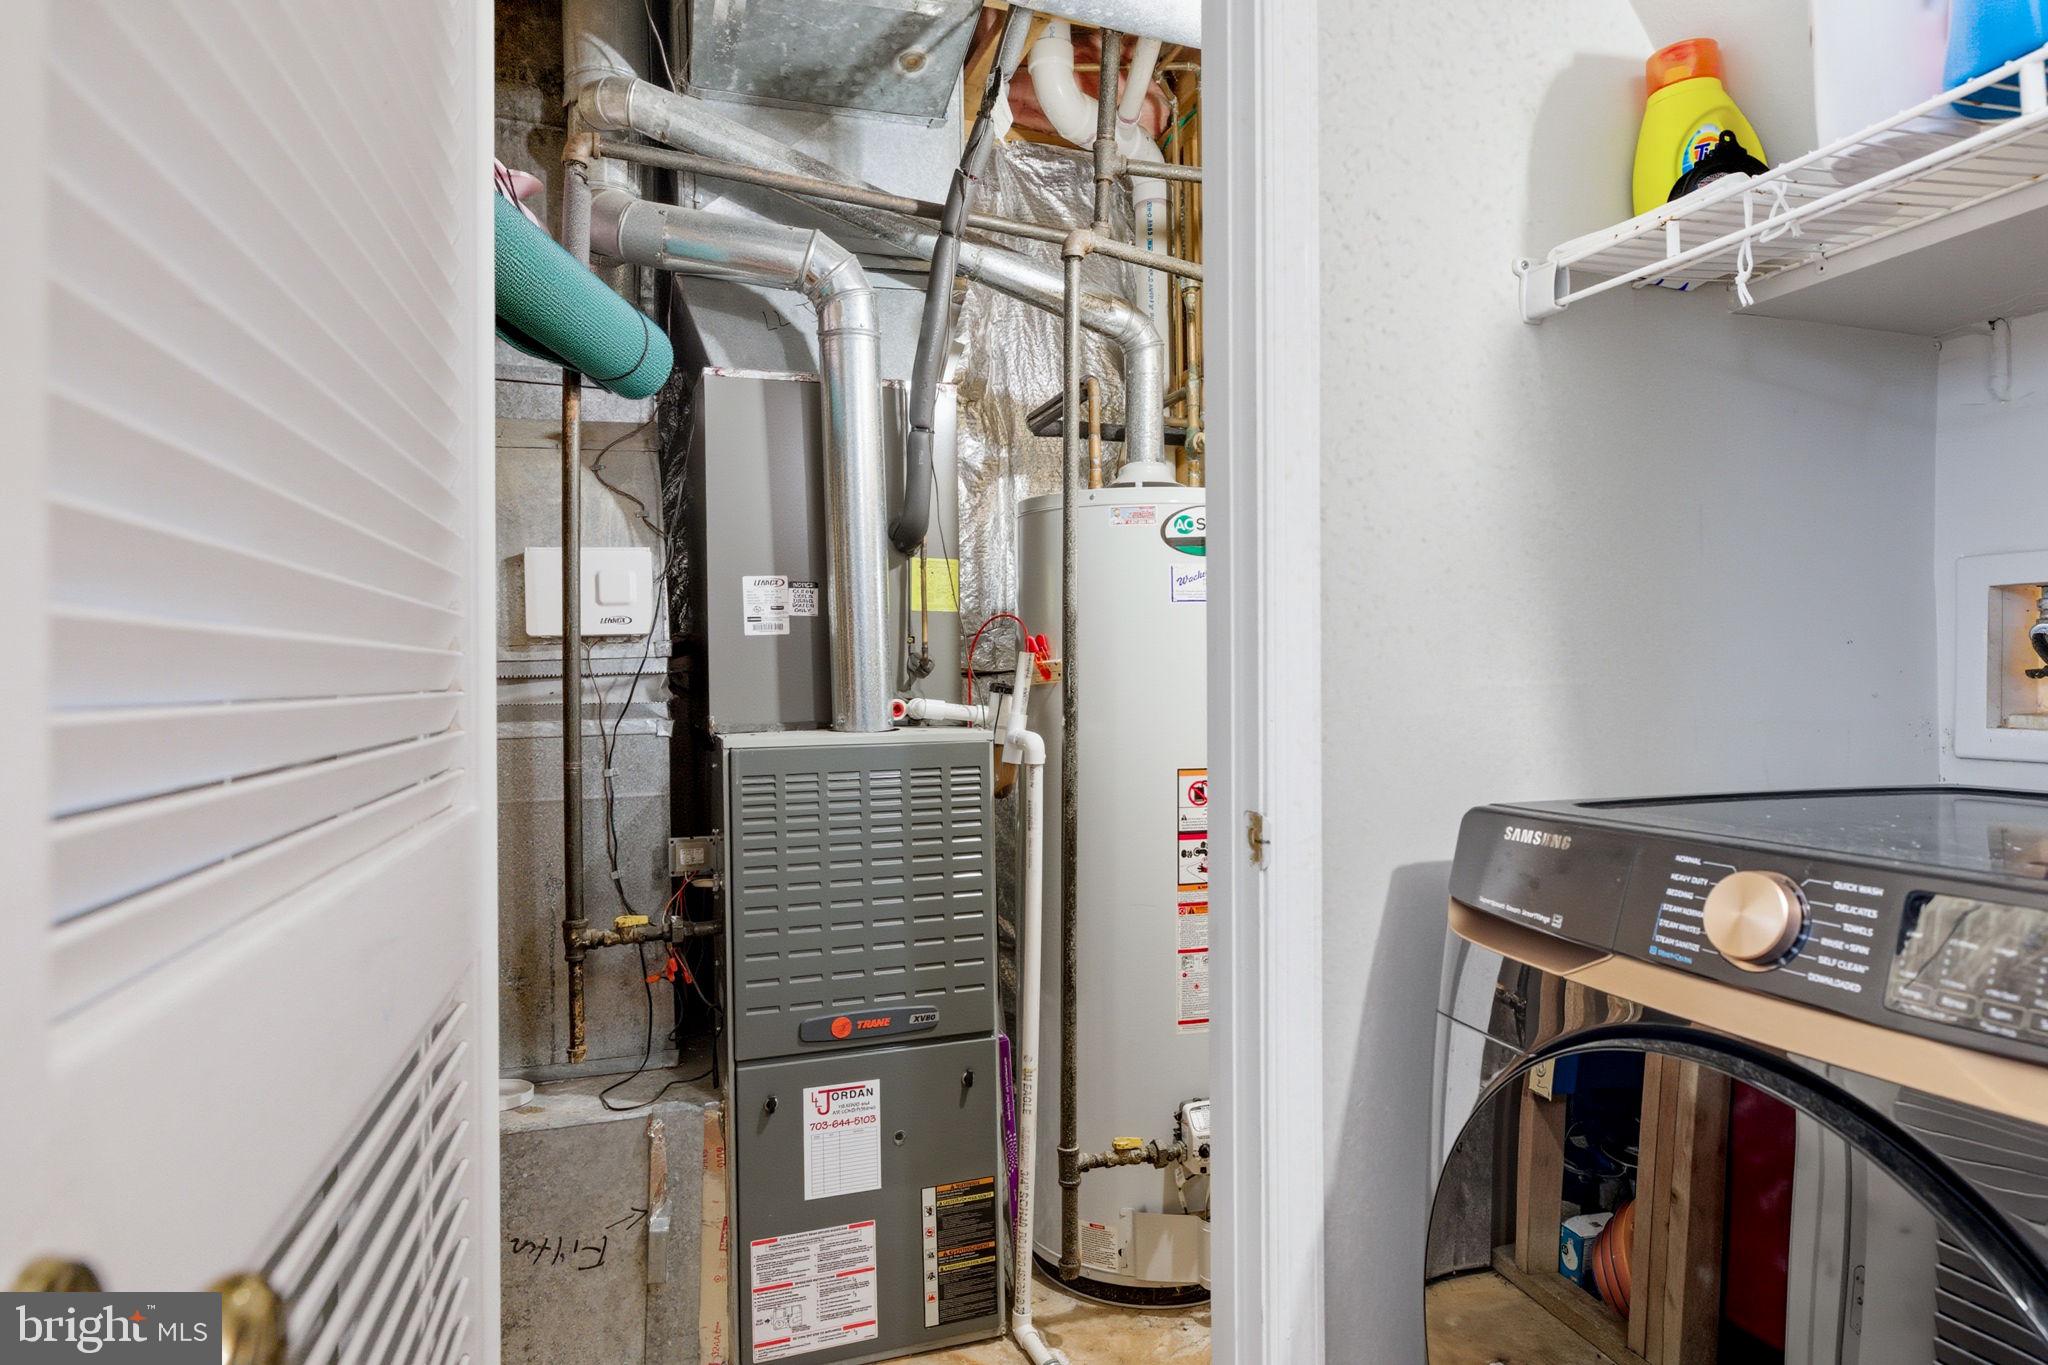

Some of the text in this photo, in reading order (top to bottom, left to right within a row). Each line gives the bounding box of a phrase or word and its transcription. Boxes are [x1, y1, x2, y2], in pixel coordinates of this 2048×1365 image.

[1503, 826, 1572, 850] SAMSUNG
[1833, 881, 1885, 897] QUICK WASH
[1835, 903, 1879, 919] DELICATES
[1842, 923, 1874, 938] TOWELS
[1818, 955, 1838, 967] SELF
[857, 1014, 936, 1030] TRANE XV80
